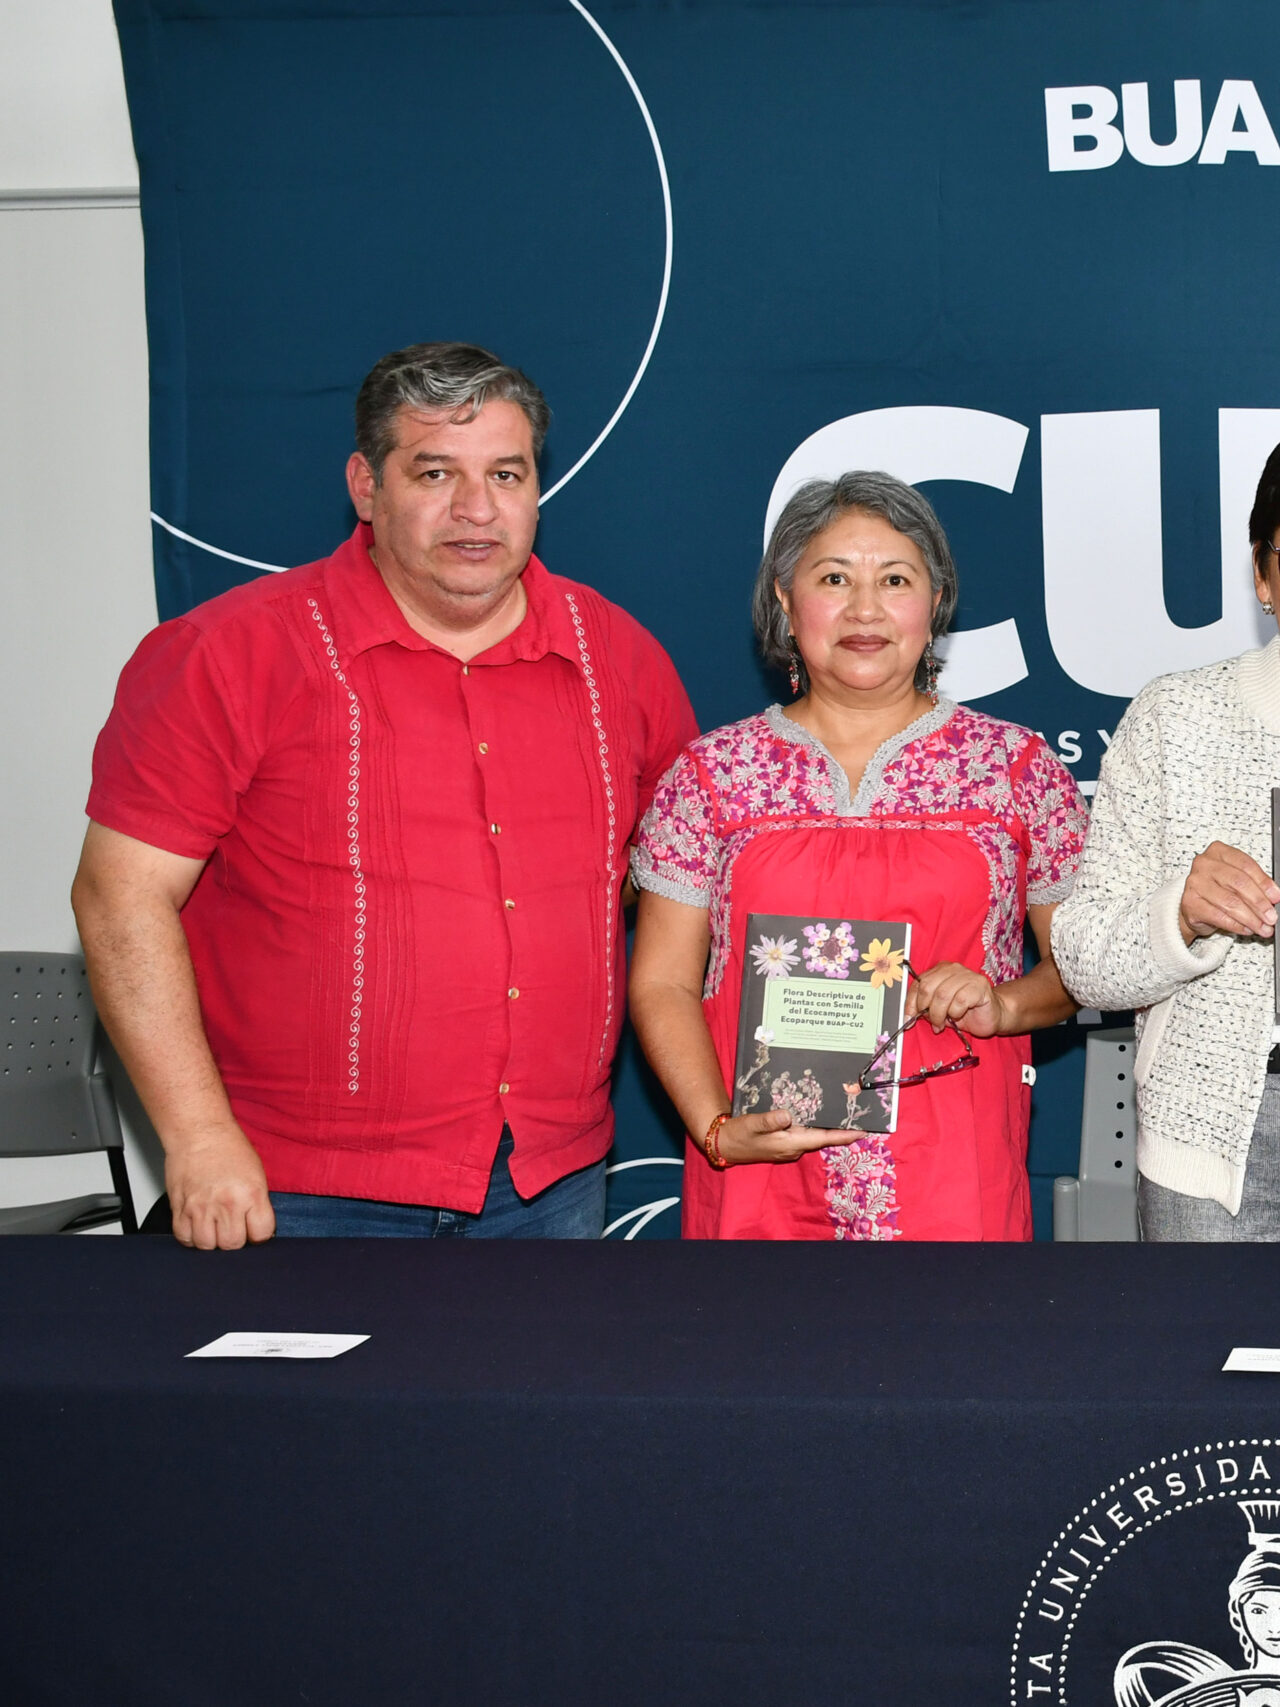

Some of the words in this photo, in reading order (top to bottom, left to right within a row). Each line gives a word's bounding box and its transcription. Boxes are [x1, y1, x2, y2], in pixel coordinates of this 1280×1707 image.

[783, 988, 804, 996] Flora
[806, 990, 853, 1000] Descriptiva
[784, 997, 814, 1006] Plantas
[833, 1001, 864, 1010] Semilla
[789, 1007, 801, 1015] del
[804, 1008, 850, 1018] Ecocampus
[781, 1016, 824, 1026] Ecoparque
